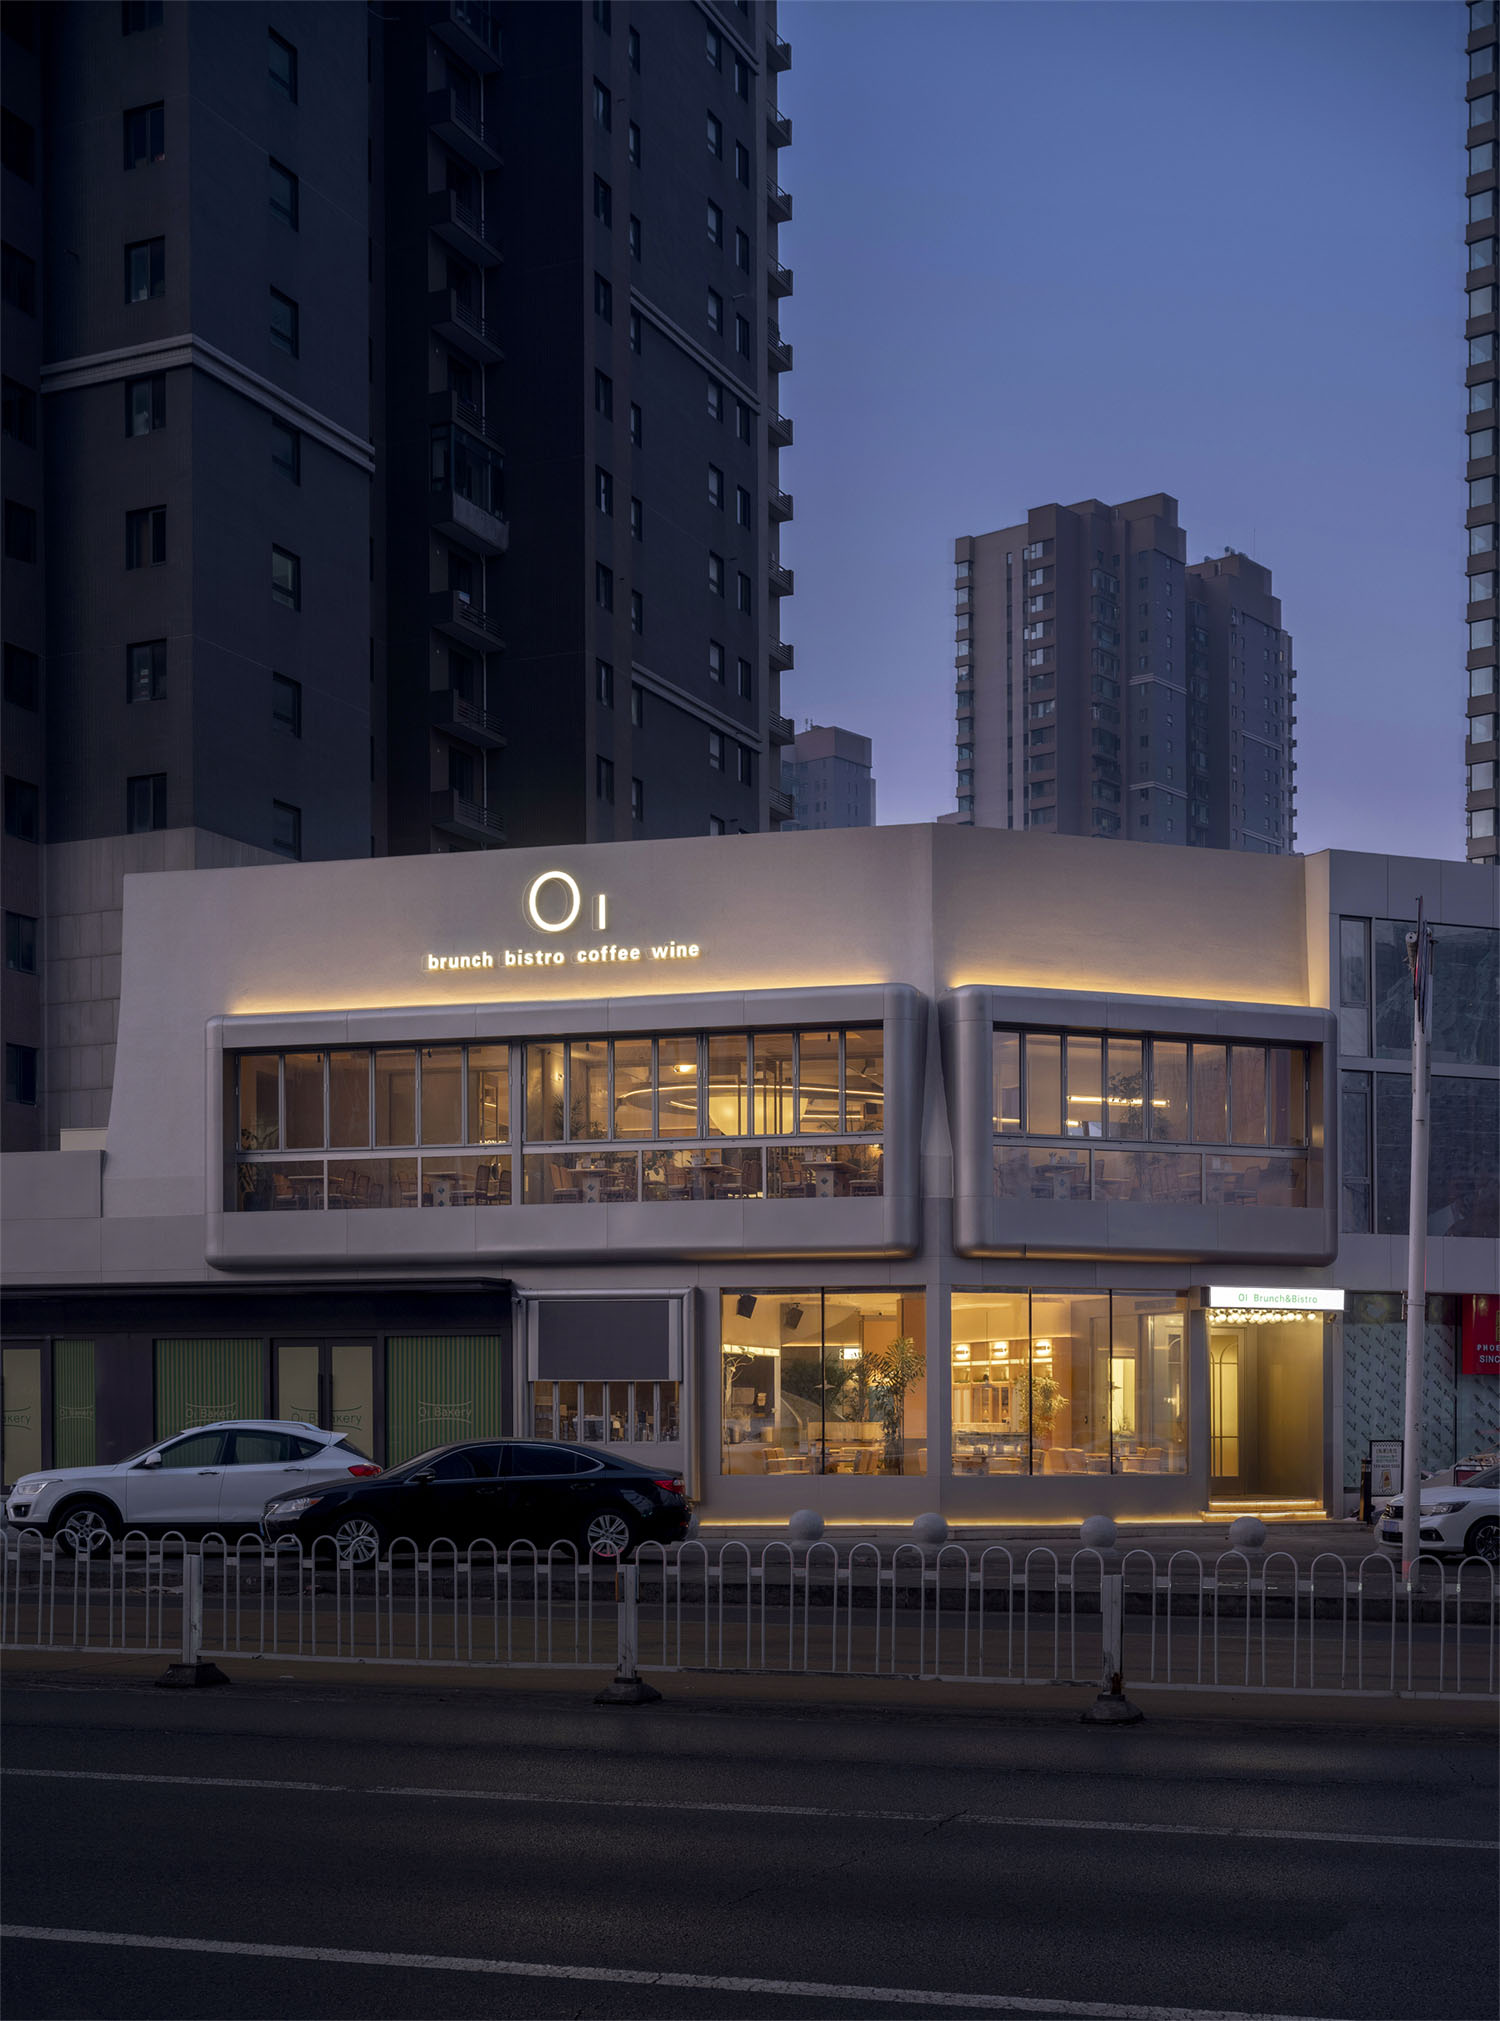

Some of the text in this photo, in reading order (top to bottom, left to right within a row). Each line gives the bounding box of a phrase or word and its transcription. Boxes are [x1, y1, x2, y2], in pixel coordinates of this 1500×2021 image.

[427, 940, 700, 971] brunch bistro coffee wine
[1253, 1293, 1318, 1304] Brunch&Bistro
[200, 1407, 237, 1420] Bakery
[434, 1406, 473, 1419] Bakery
